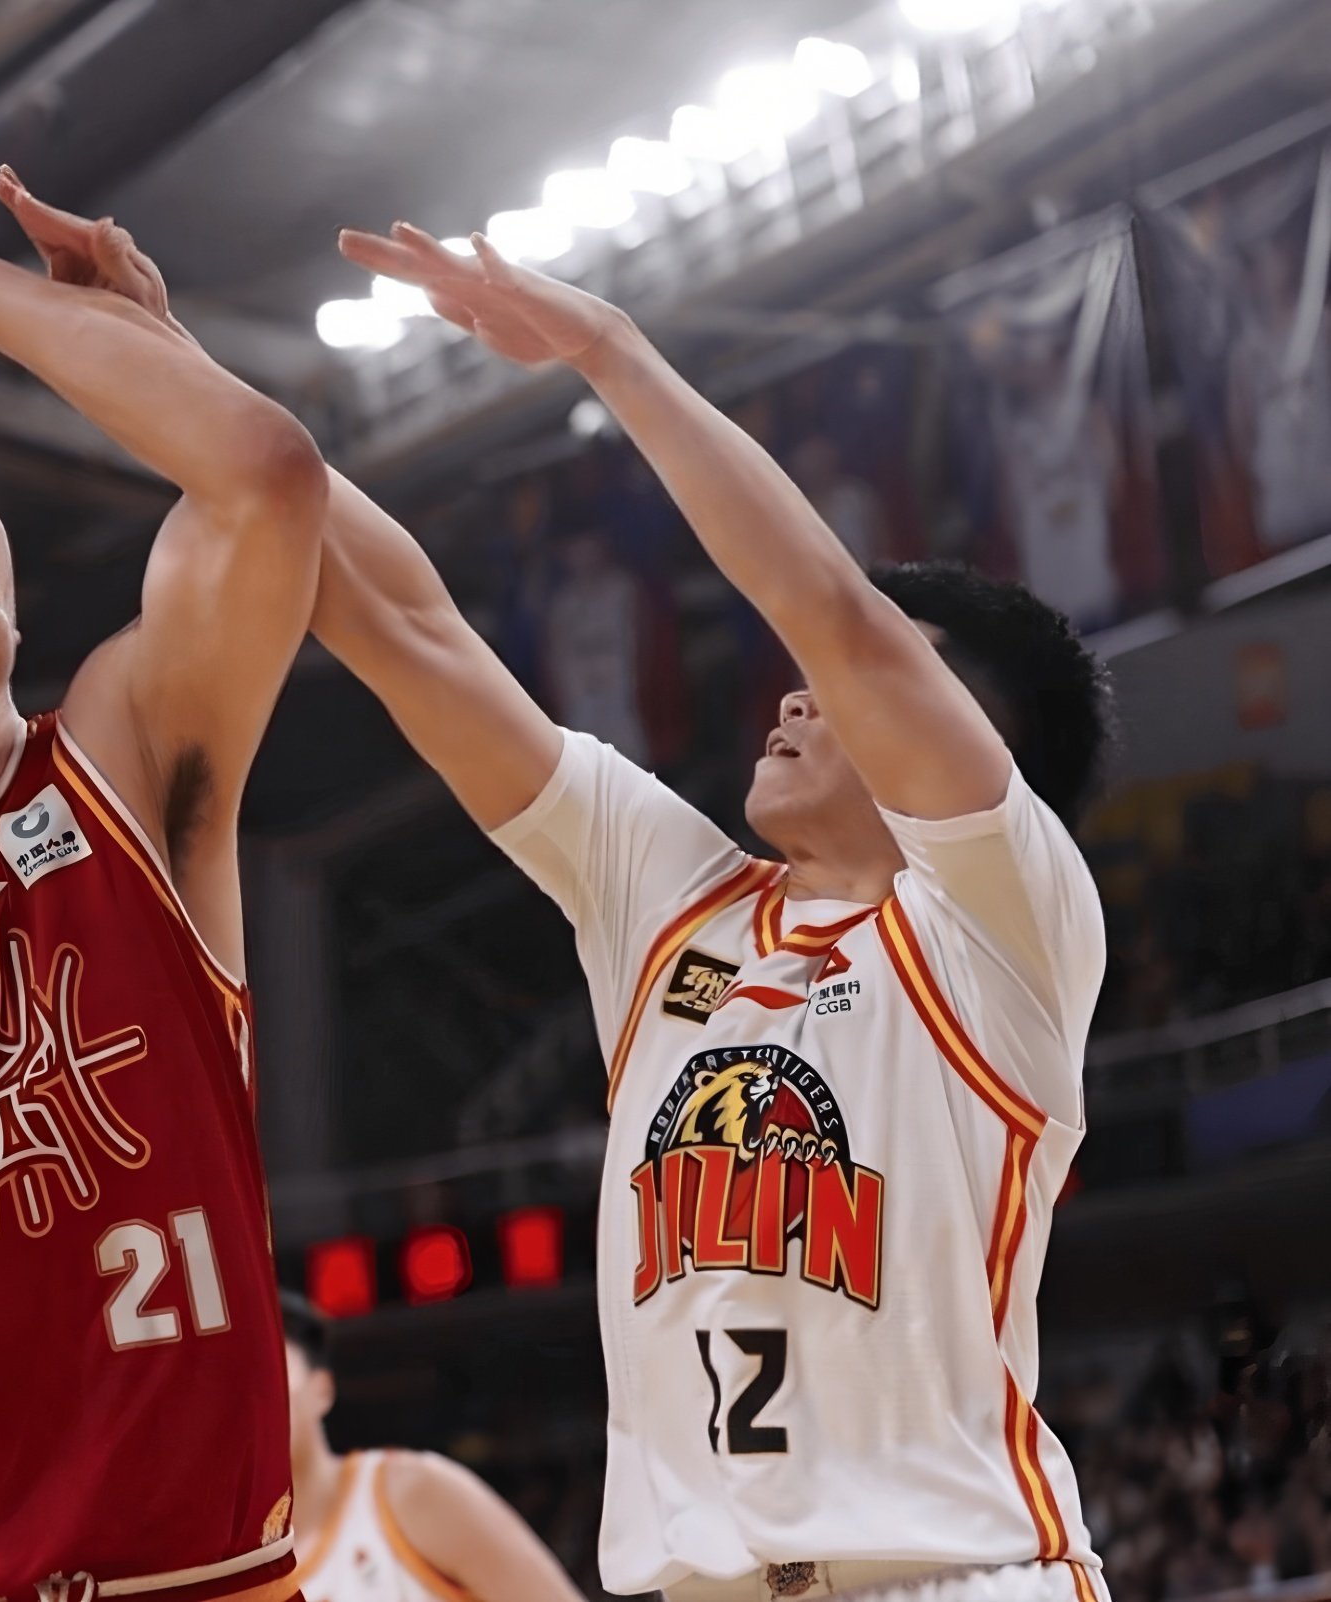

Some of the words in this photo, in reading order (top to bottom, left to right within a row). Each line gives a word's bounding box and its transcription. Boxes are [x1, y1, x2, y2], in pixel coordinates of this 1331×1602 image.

[781, 1053, 840, 1130] TIGERS
[93, 1206, 232, 1352] 21
[630, 1144, 885, 1311] JILIN
[695, 1329, 788, 1455] 12
